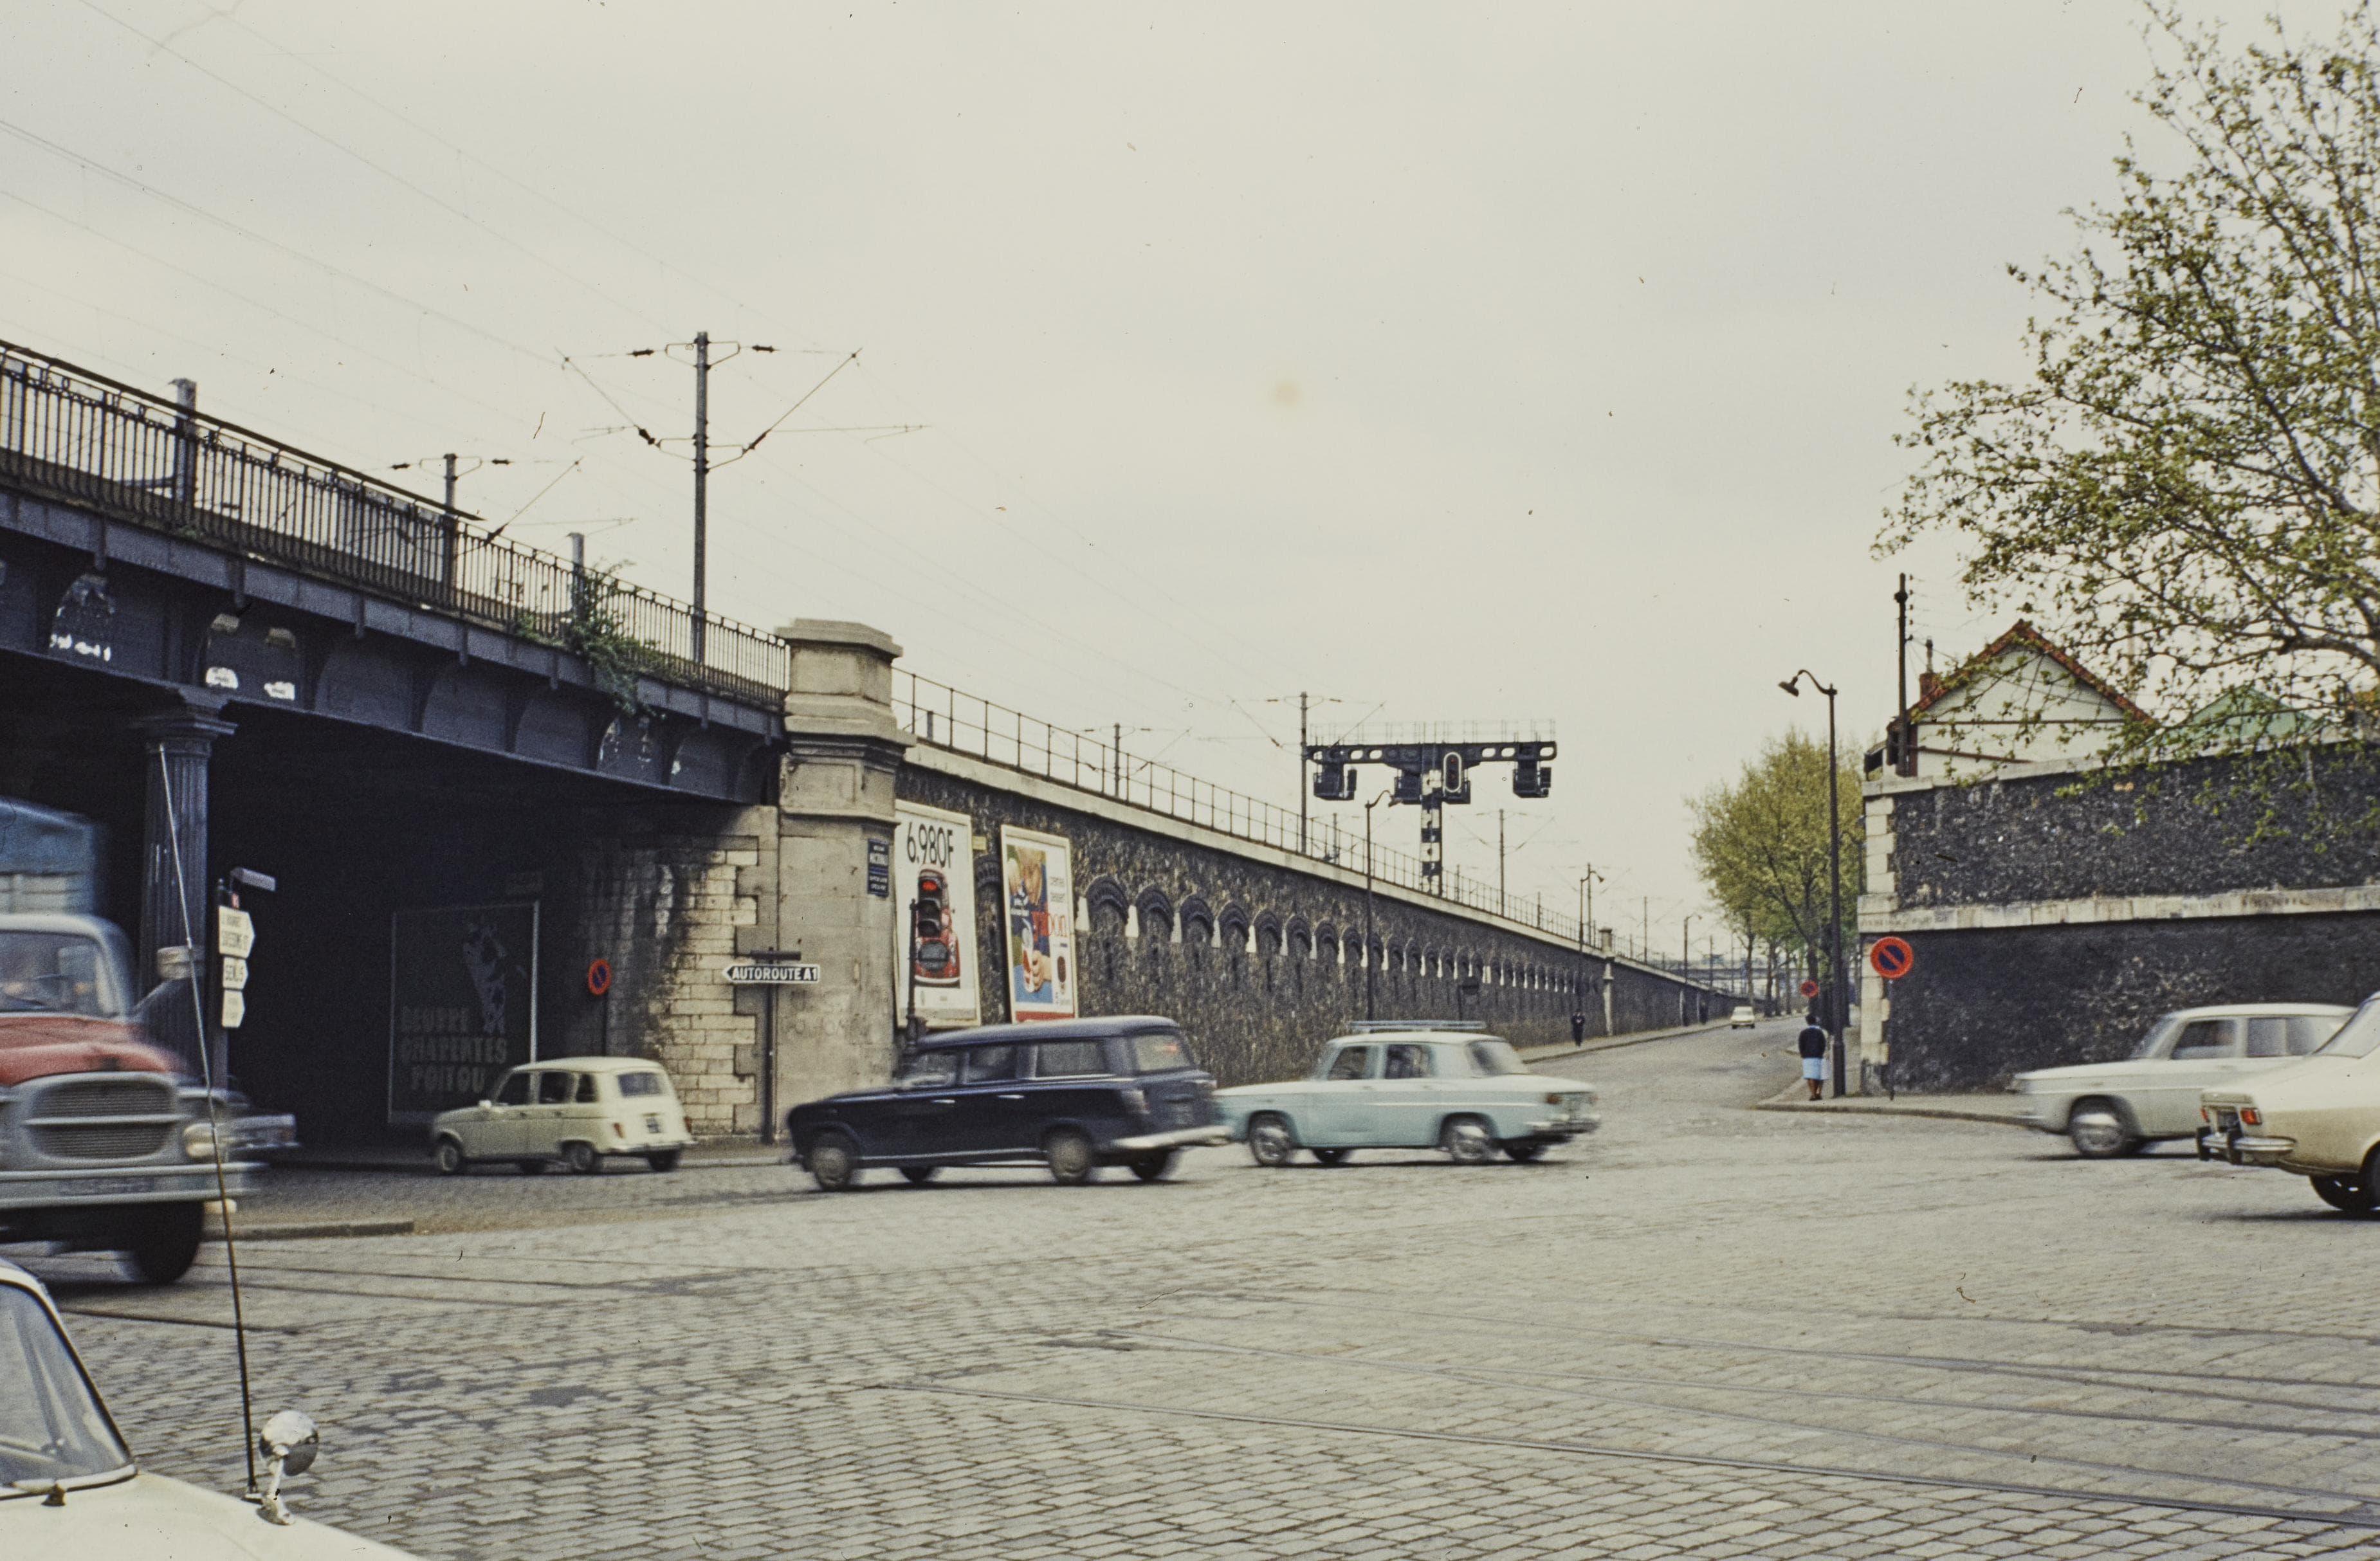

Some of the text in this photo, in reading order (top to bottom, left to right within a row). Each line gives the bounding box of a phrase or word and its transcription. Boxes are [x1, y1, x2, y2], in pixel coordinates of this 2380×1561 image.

[732, 966, 818, 981] AUTOROUTE A1
[410, 1065, 486, 1093] POITOU
